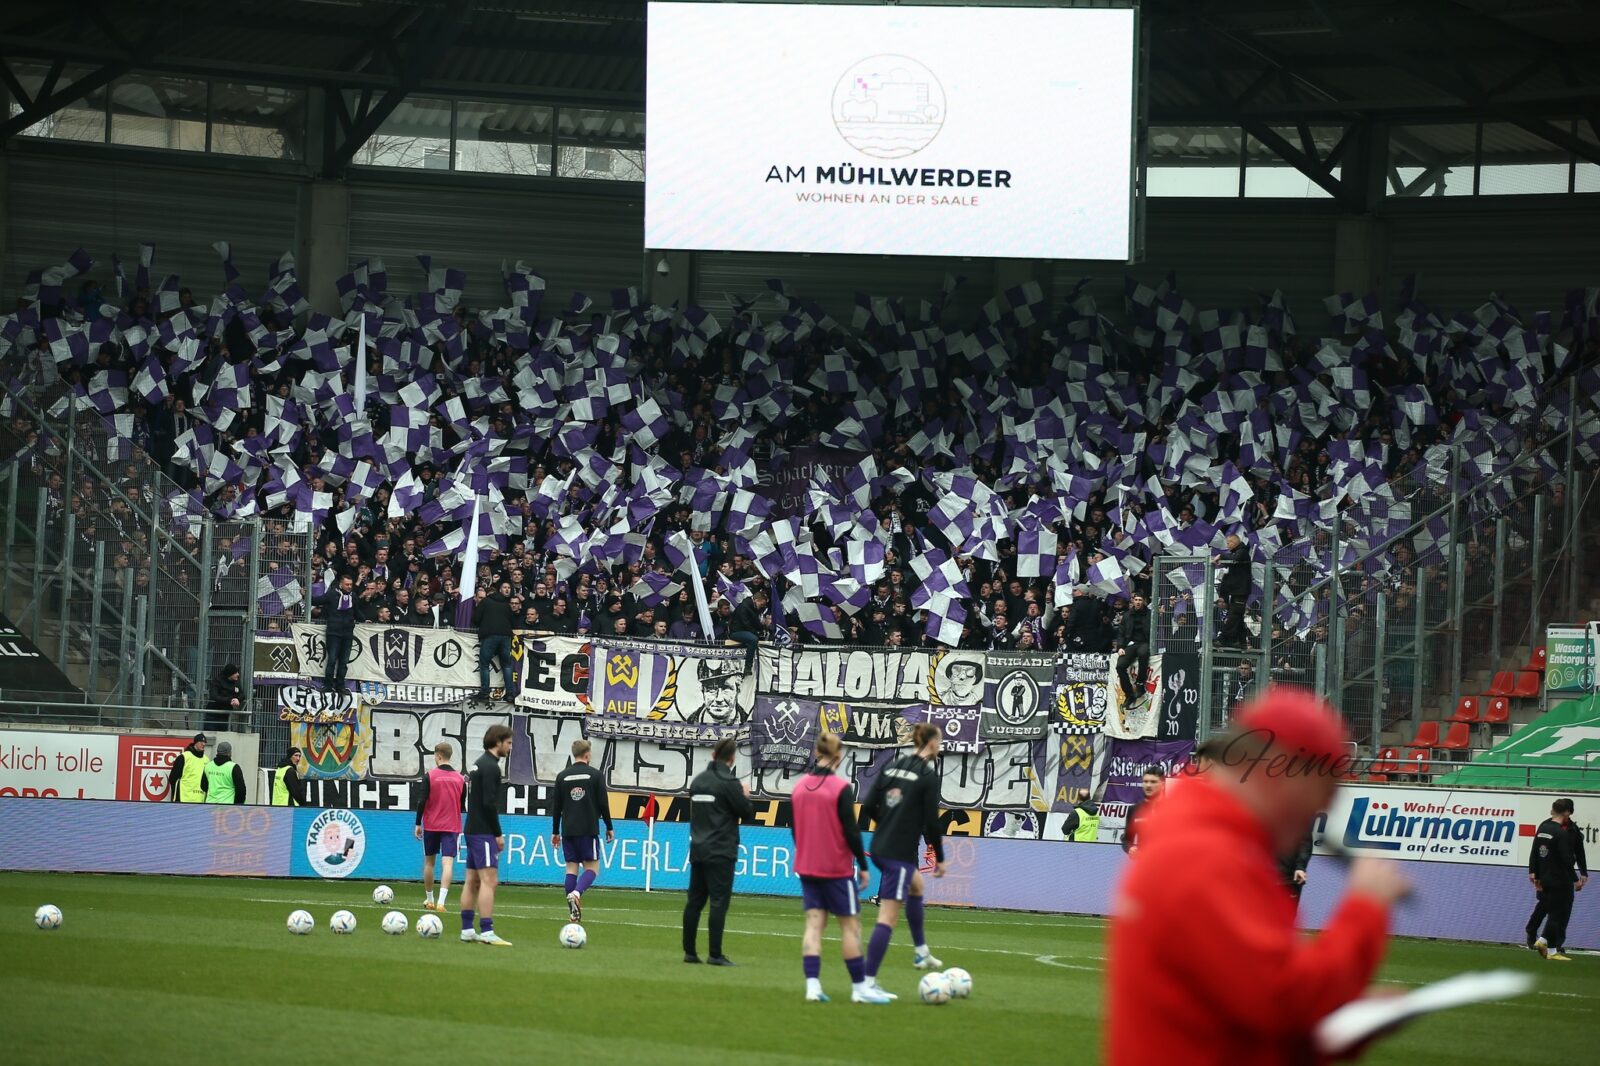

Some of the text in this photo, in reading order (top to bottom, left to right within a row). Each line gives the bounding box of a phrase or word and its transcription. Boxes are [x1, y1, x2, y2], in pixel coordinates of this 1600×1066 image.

[765, 162, 1012, 189] AM MÜHLWERDER
[796, 192, 980, 207] WOHNEN AN DER SAALE
[1554, 643, 1585, 654] Wasser
[385, 658, 408, 670] AUE
[987, 656, 1052, 667] BRIGADE
[541, 698, 577, 707] COMPANY
[606, 699, 637, 715] AUE
[586, 717, 751, 742] ERZBRIGADE
[987, 725, 1041, 736] JUGEND
[56, 747, 103, 773] tolle
[138, 751, 177, 767] HFC
[1403, 801, 1515, 818] Wohn-Centrum
[307, 809, 363, 848] TARIFEGURU
[1342, 797, 1516, 851] Lührmann
[1406, 843, 1510, 857] an der Saline
